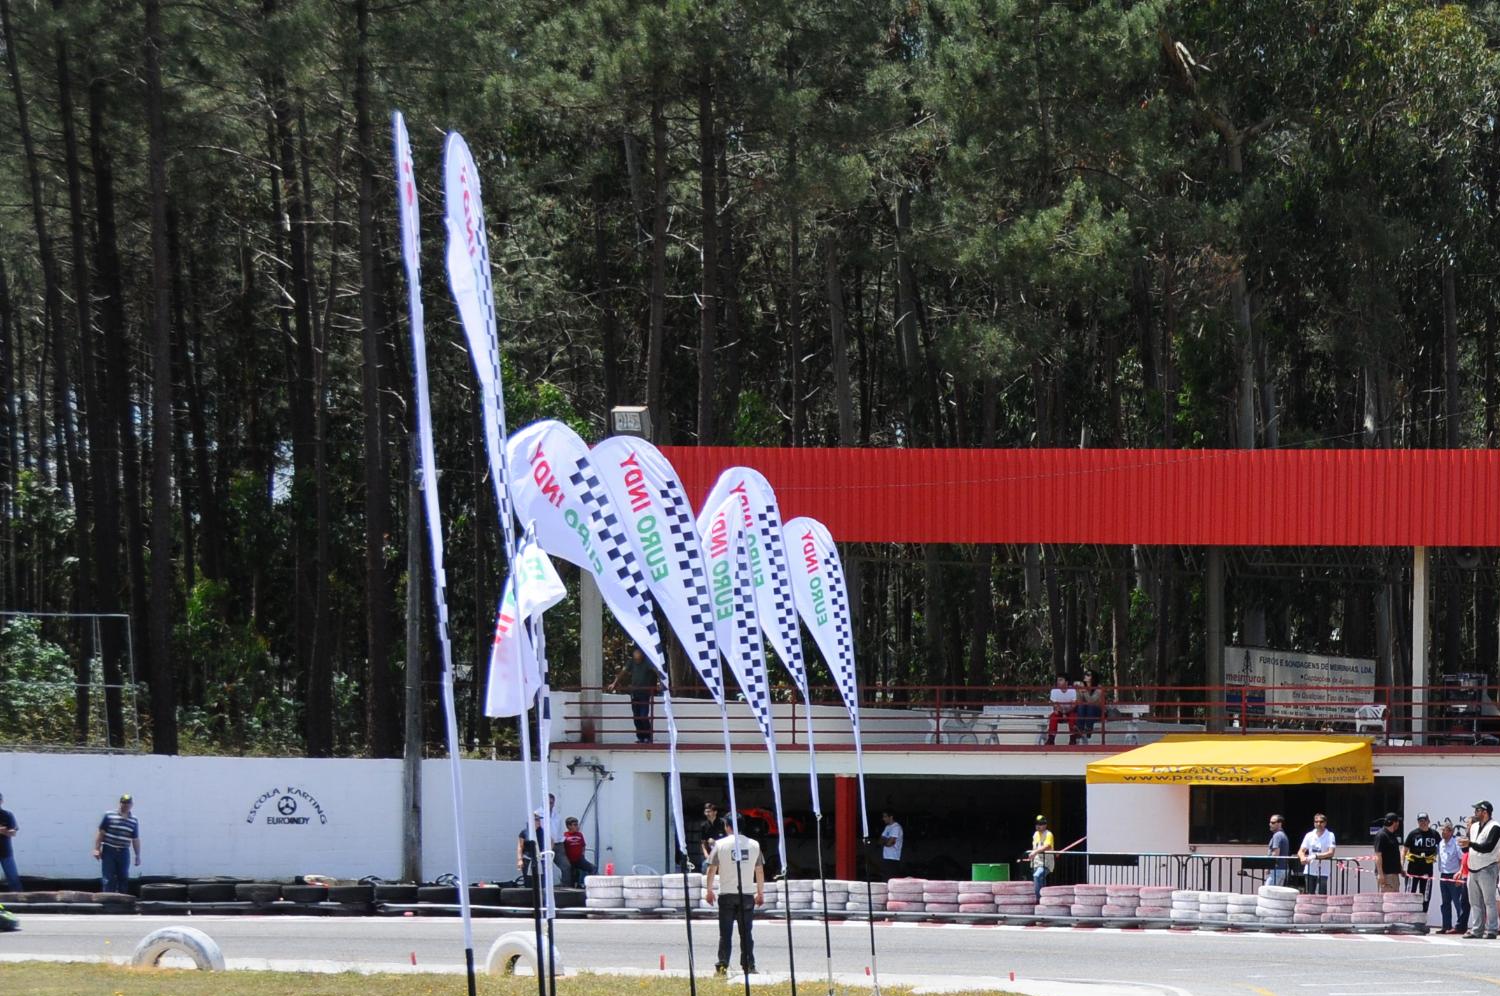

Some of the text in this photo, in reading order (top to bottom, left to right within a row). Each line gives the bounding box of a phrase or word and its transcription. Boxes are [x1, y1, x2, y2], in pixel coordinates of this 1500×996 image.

[1259, 656, 1279, 666] FUROS
[1123, 774, 1278, 784] www.pestronix.pt
[246, 786, 328, 825] ESCOLA KARTING
